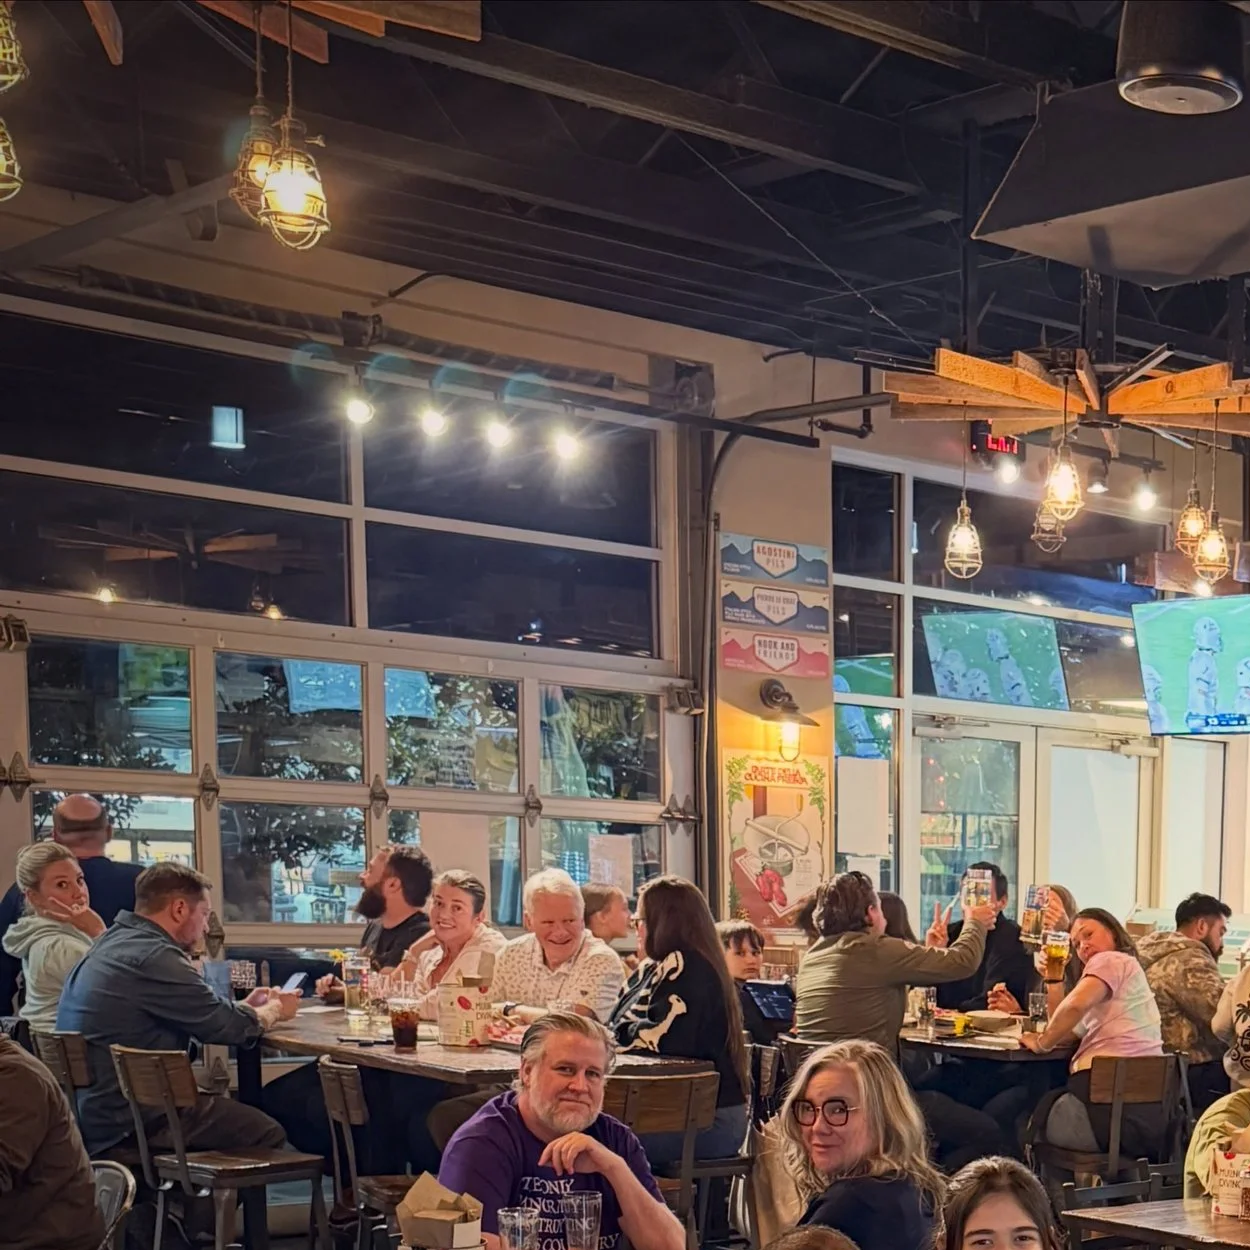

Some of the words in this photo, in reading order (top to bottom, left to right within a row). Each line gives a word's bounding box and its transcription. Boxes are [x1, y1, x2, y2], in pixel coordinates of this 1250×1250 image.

[756, 545, 795, 559] AGOSTINI
[766, 559, 785, 569] PILS
[780, 641, 795, 652] AND
[758, 650, 795, 661] FRIENDS
[1220, 1170, 1240, 1178] MULIN
